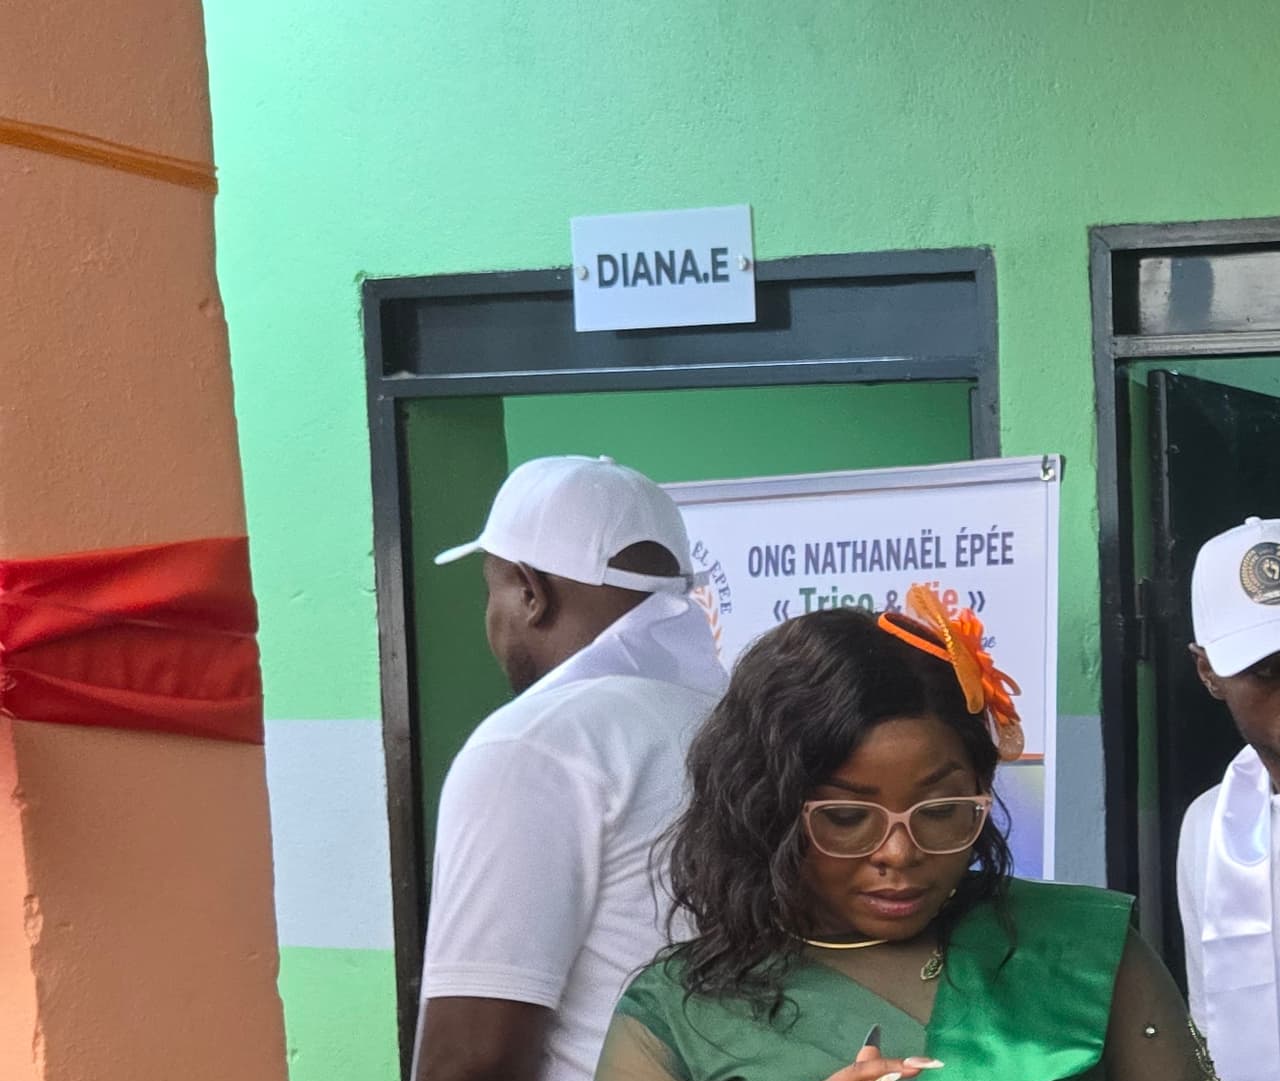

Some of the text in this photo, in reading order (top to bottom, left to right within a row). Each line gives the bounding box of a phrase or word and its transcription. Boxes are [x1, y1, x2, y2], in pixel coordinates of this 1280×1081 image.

[596, 247, 731, 289] DIANA.E
[748, 525, 1015, 578] ONG NATHANAËL ÉPÉE
